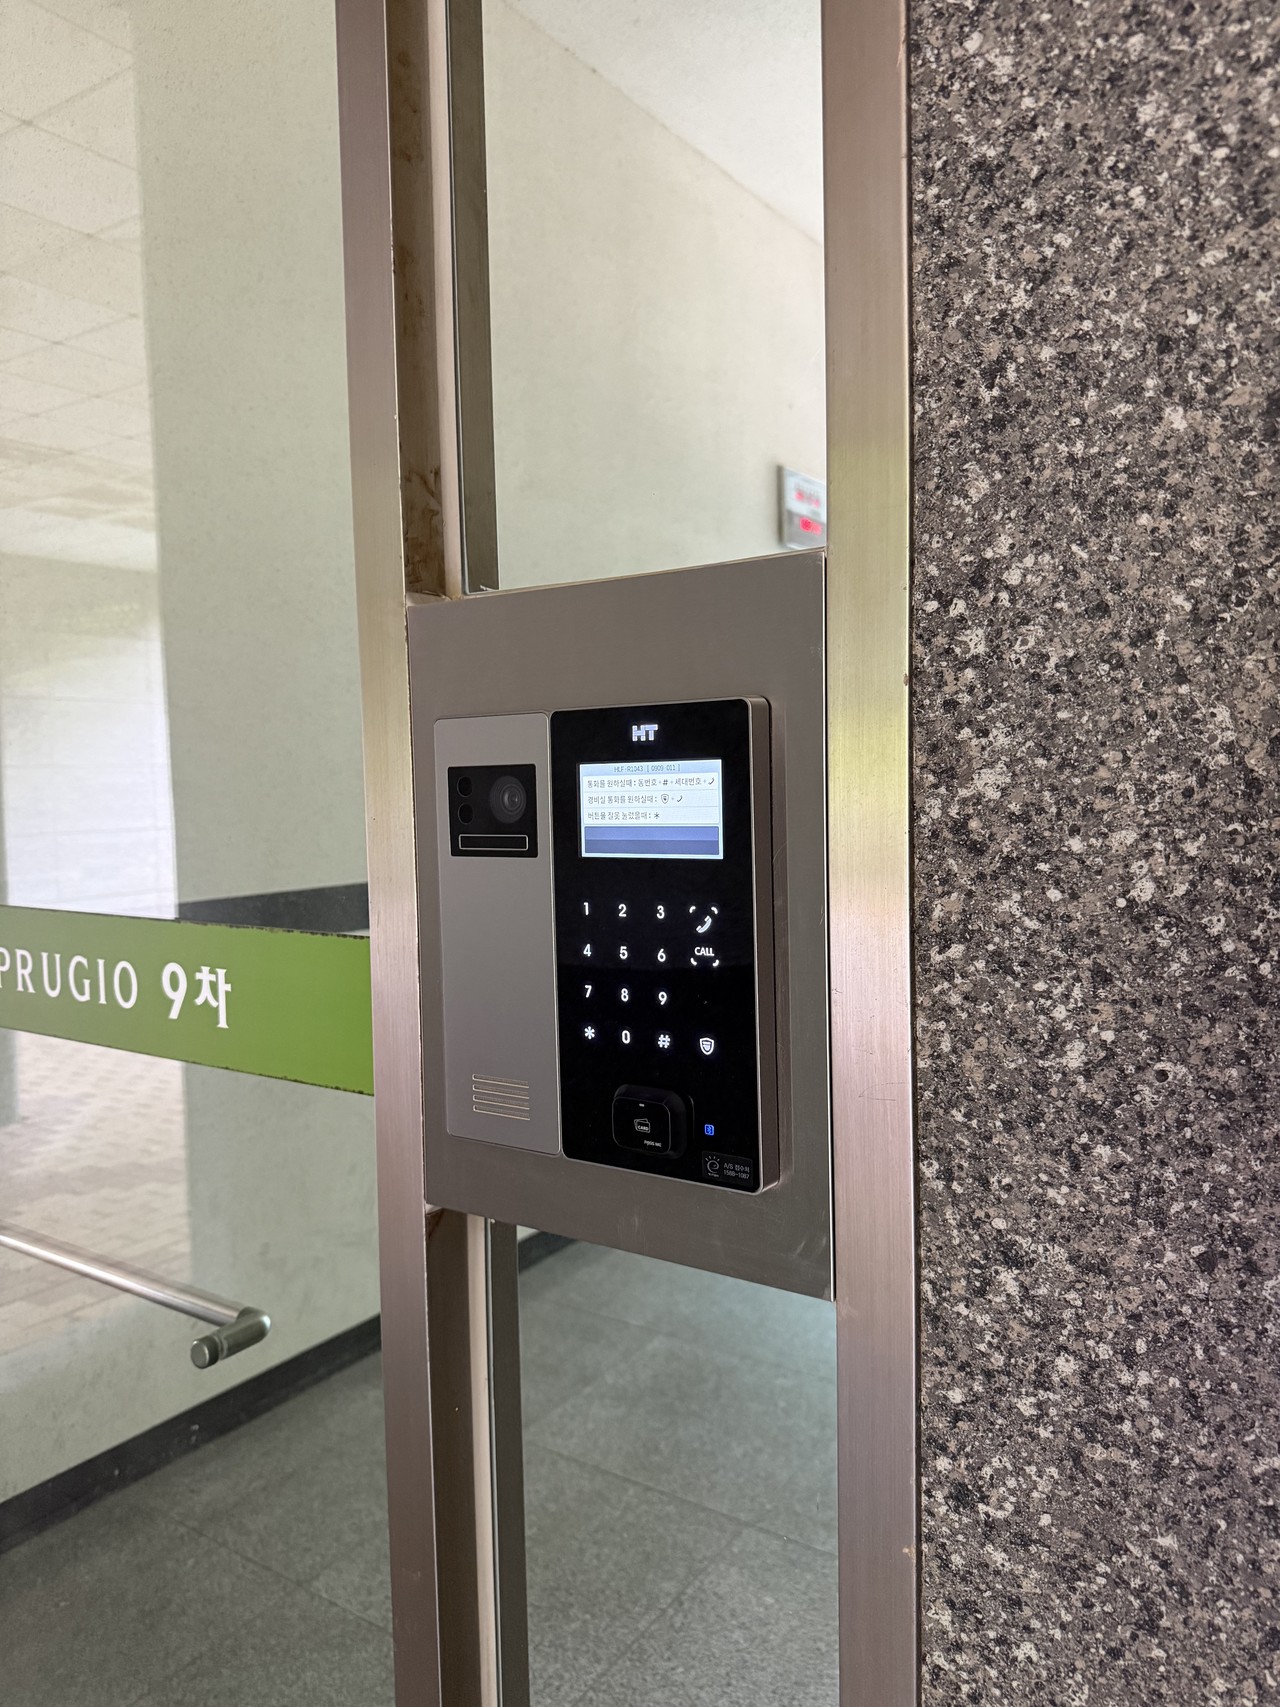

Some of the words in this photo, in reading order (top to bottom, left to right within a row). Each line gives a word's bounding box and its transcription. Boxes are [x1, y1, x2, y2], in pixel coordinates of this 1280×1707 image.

[632, 723, 659, 742] HT
[587, 779, 605, 788] 통화를
[638, 778, 658, 787] 동번호
[675, 776, 702, 786] 세대번호
[587, 795, 606, 804] 경비실
[607, 795, 626, 804] 통화를
[587, 812, 606, 820] 버튼을
[607, 811, 621, 820] 잘못
[583, 902, 589, 916] 1
[618, 903, 627, 917] 2
[656, 905, 665, 919] 3
[583, 943, 592, 957] 4
[619, 946, 628, 960] 5
[657, 948, 667, 962] 6
[694, 946, 715, 957] CALL
[0, 947, 138, 1010] PRUGIO
[162, 961, 232, 1029] 9차
[584, 984, 592, 998] 7
[620, 988, 629, 1002] 8
[658, 991, 668, 1005] 9
[621, 1030, 631, 1044] 0
[657, 1034, 671, 1049] #
